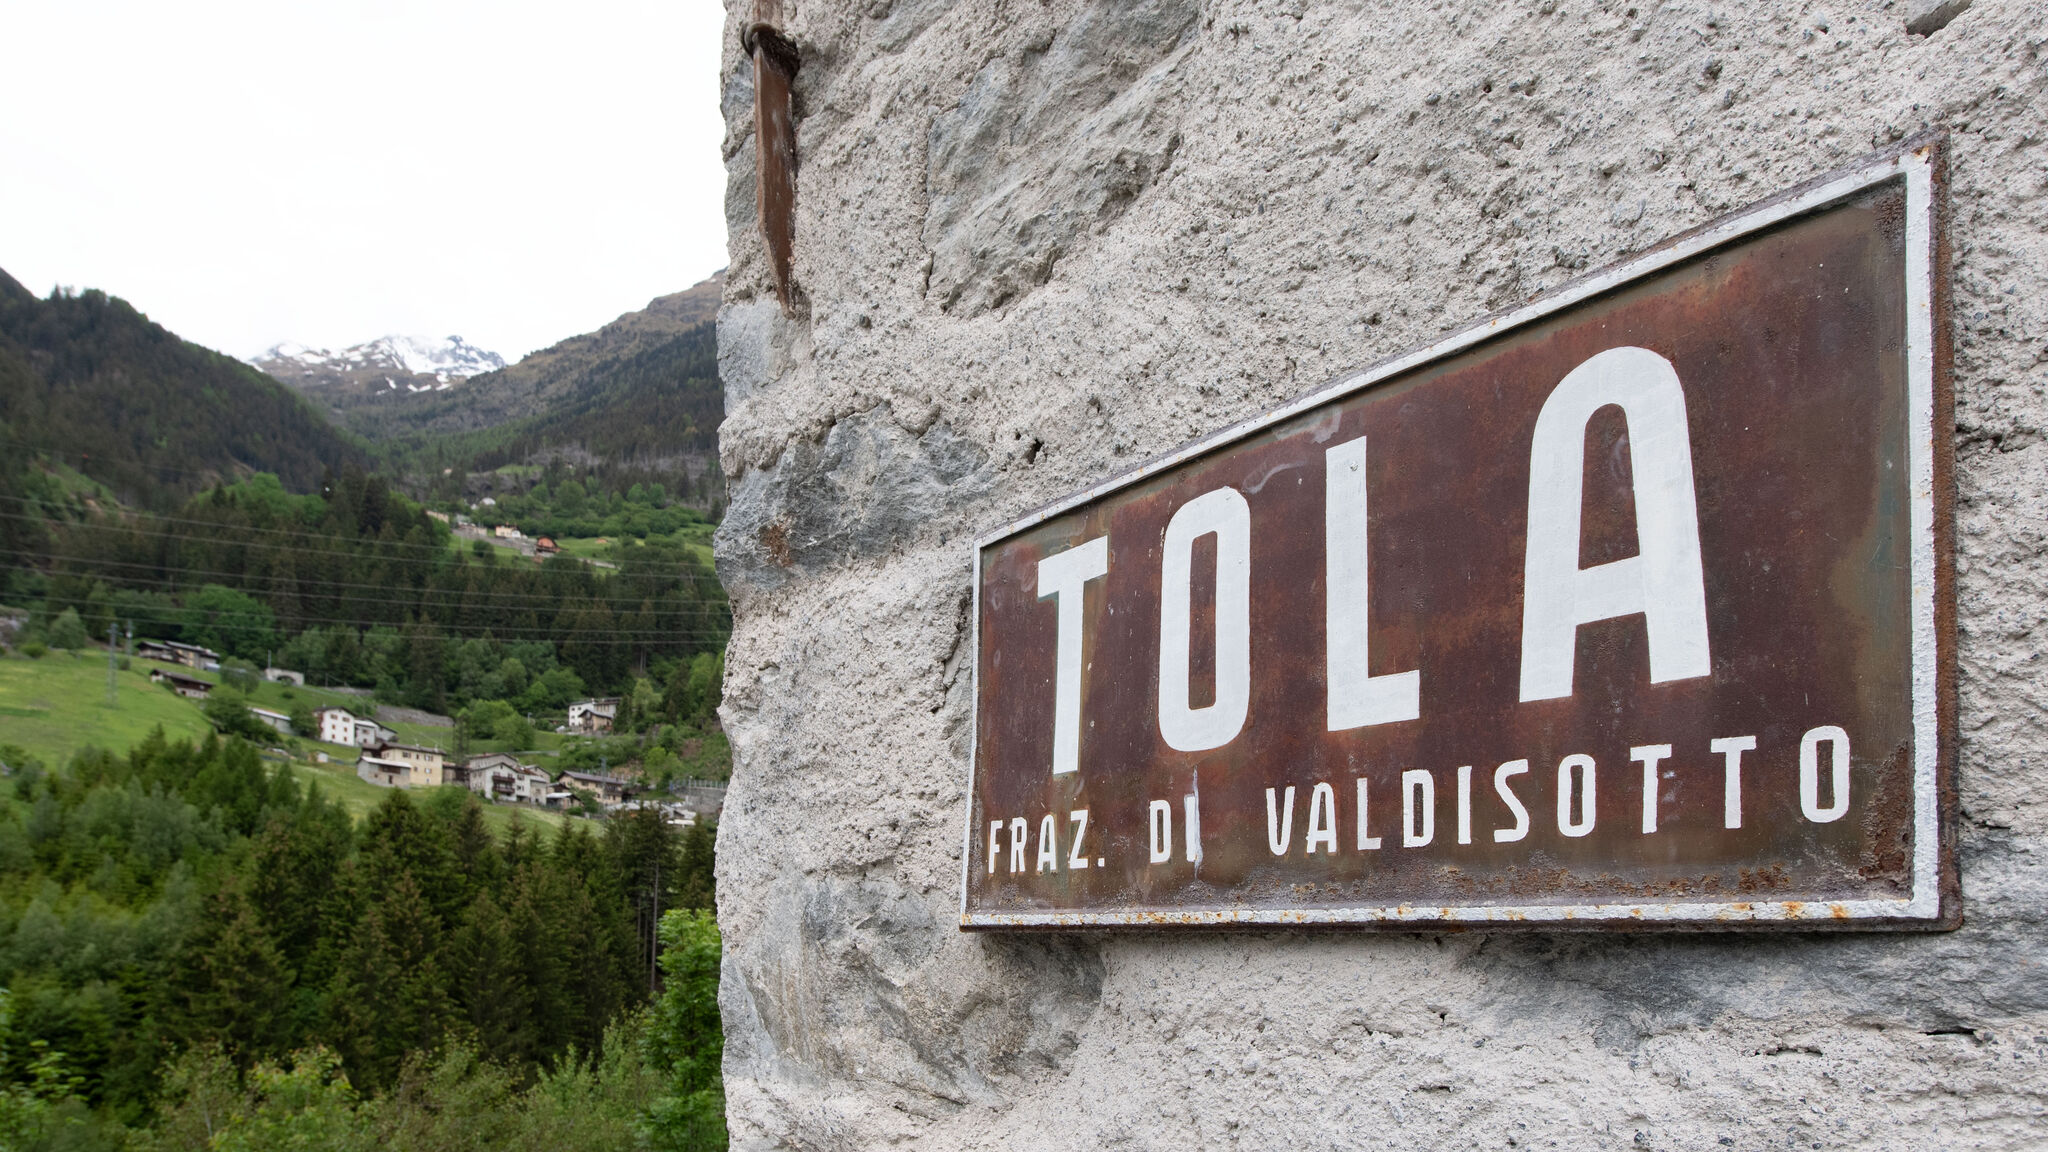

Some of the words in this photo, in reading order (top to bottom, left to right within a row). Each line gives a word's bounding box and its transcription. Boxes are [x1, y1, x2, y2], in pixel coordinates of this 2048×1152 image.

[1035, 345, 1712, 777] TOLA
[988, 809, 1106, 874] FRAZ.
[1148, 792, 1204, 866] DI
[1265, 725, 1851, 857] VALDISOTTO
